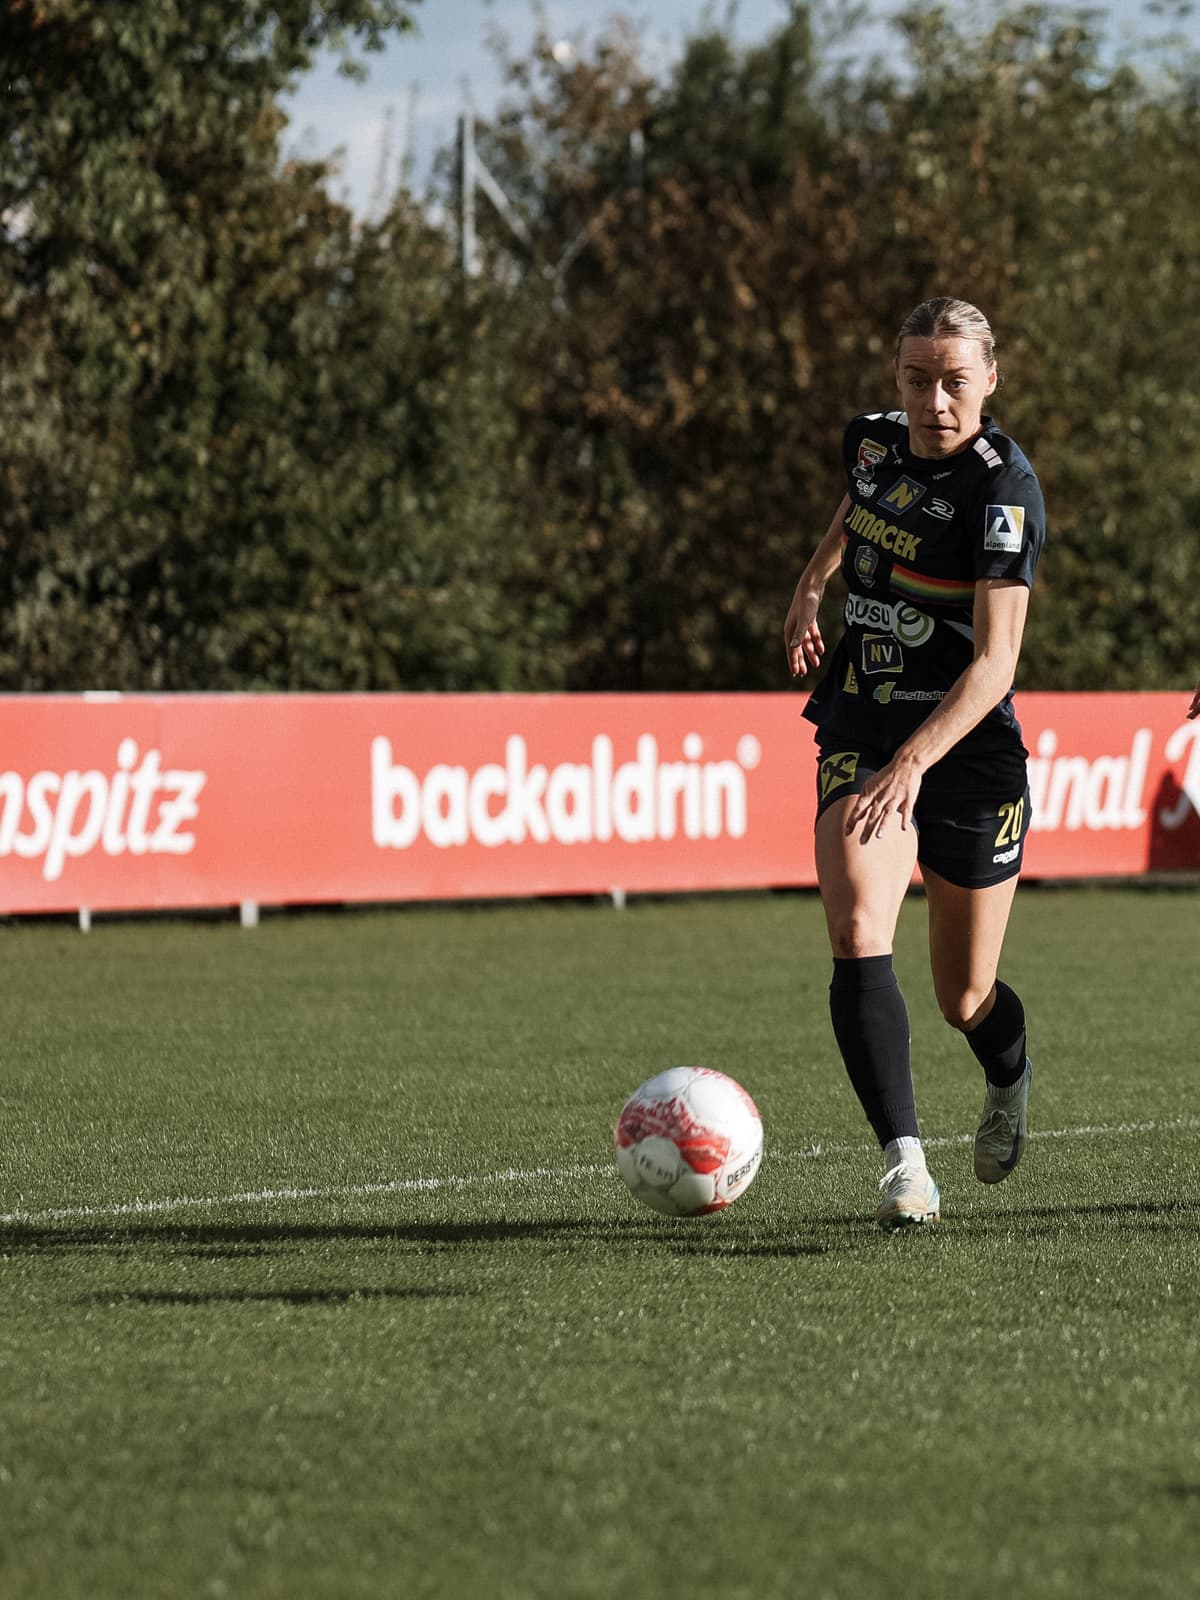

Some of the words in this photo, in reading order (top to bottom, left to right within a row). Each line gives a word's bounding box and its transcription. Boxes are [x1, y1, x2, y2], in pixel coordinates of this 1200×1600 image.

[871, 644, 893, 662] NV
[1025, 728, 1152, 832] inal
[994, 796, 1024, 848] 20
